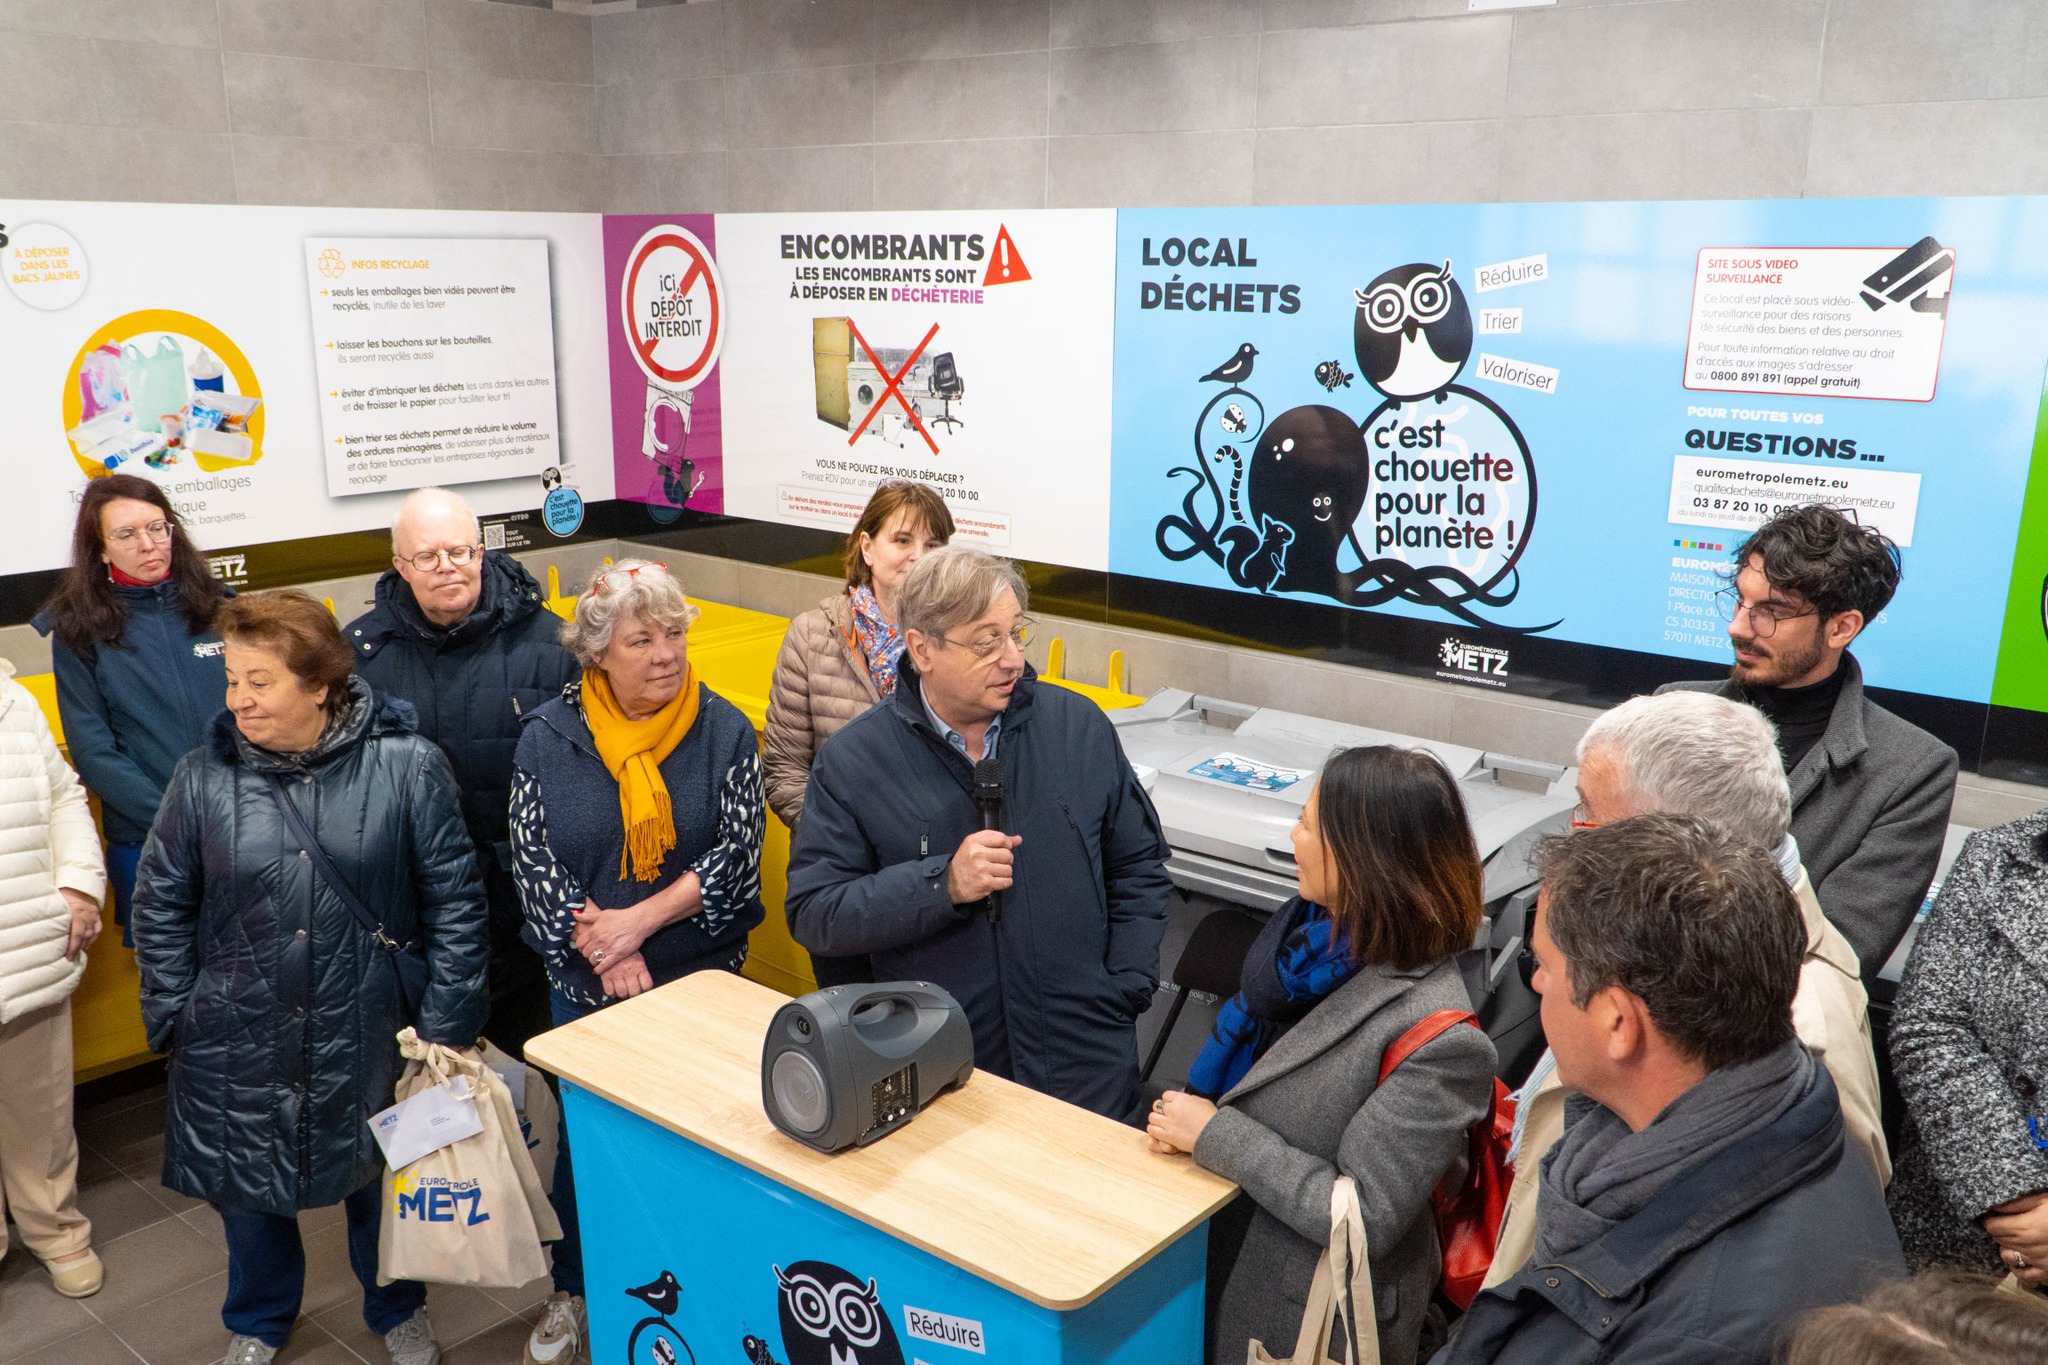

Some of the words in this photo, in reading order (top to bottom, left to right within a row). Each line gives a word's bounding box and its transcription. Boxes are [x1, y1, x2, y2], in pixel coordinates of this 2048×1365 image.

[15, 247, 23, 258] À
[24, 246, 70, 258] DÉPOSER
[781, 233, 985, 261] ENCOMBRANTS
[1142, 237, 1257, 267] LOCAL
[20, 260, 49, 271] DANS
[52, 259, 68, 269] LES
[351, 260, 378, 269] INFOS
[381, 260, 430, 269] RECYCLAGE
[1708, 259, 1729, 269] SITE
[1731, 259, 1762, 269] SOUS
[1765, 259, 1799, 269] VIDEO
[12, 273, 40, 284] BACS
[43, 270, 80, 282] JAUNES
[795, 266, 819, 280] LES
[823, 266, 931, 283] ENCOMBRANTS
[935, 269, 976, 284] SONT
[1479, 260, 1544, 288] Réduire
[1706, 273, 1783, 284] SURVEILLANCE
[332, 287, 354, 297] seuls
[357, 287, 368, 296] les
[371, 286, 421, 298] emballages
[424, 286, 441, 295] bien
[444, 285, 465, 295] vidés
[467, 286, 499, 296] peuvent
[501, 285, 516, 294] être
[790, 282, 800, 299] À
[802, 282, 865, 301] DÉPOSER
[869, 287, 887, 301] EN
[891, 284, 984, 304] DÉCHÈTERIE
[1140, 273, 1301, 314] DÉCHETS
[1704, 293, 1717, 304] Ce
[1720, 293, 1744, 304] local
[1746, 295, 1761, 305] est
[1763, 294, 1792, 306] placé
[1794, 297, 1819, 306] sous
[651, 295, 693, 318] DÉPÔT
[1702, 308, 1761, 319] surveillance
[1763, 311, 1787, 321] pour
[1790, 310, 1809, 320] des
[1812, 311, 1851, 321] raisons
[645, 320, 702, 338] INTERDIT
[1483, 312, 1519, 331] Trier
[1700, 322, 1713, 332] de
[1716, 322, 1755, 333] sécurité
[1757, 324, 1776, 334] des
[1779, 324, 1807, 335] biens
[1809, 326, 1820, 336] et
[1822, 325, 1841, 336] des
[1844, 328, 1904, 338] personnes.
[337, 340, 365, 349] laisser
[367, 339, 379, 348] les
[382, 337, 423, 348] bouchons
[440, 336, 451, 345] les
[1698, 341, 1720, 352] Pour
[1724, 343, 1748, 353] toute
[1751, 343, 1809, 355] information
[1811, 346, 1850, 357] relative
[1852, 349, 1866, 358] au
[1869, 347, 1895, 359] droit
[1696, 356, 1733, 367] d'accès
[1736, 359, 1755, 368] aux
[1757, 358, 1795, 371] images
[1798, 360, 1853, 372] s'adresser
[1482, 357, 1554, 390] Valoriser
[1710, 370, 1738, 381] 0800
[1740, 372, 1759, 382] 891
[1762, 373, 1780, 383] 891
[1783, 374, 1818, 386] (appel
[1820, 377, 1861, 389] gratuit)
[341, 389, 365, 398] éviter
[368, 386, 416, 397] d'imbriquer
[419, 384, 431, 393] les
[433, 382, 464, 392] déchets
[467, 381, 477, 390] les
[495, 380, 513, 389] dans
[515, 379, 525, 387] les
[527, 378, 549, 386] autres
[1687, 406, 1727, 419] POUR
[1730, 408, 1788, 423] TOUTES
[1792, 412, 1824, 425] VOS
[345, 435, 363, 444] bien
[366, 433, 382, 442] trier
[384, 433, 397, 441] ses
[400, 430, 430, 440] déchets
[433, 428, 461, 439] permet
[462, 426, 472, 435] de
[474, 424, 500, 433] réduire
[502, 423, 509, 431] le
[510, 421, 537, 430] volume
[1374, 418, 1446, 449] c'est
[1684, 428, 1885, 462] QUESTIONS...
[816, 458, 836, 470] VOUS
[837, 461, 847, 471] NE
[849, 462, 878, 474] POUVEZ
[880, 466, 894, 476] PAS
[896, 468, 917, 479] VOUS
[920, 469, 957, 483] DÉPLACER
[960, 475, 964, 484] ?
[1374, 452, 1514, 482] chouette
[175, 476, 251, 494] emballages
[801, 470, 824, 482] Prenez
[825, 474, 839, 483] RDV
[840, 476, 856, 487] pour
[857, 479, 866, 487] un
[1696, 468, 1849, 489] eurometropolemetz.eu
[945, 488, 955, 498] 20
[958, 489, 966, 499] 10
[968, 491, 979, 500] 00
[1374, 489, 1447, 523] pour
[1458, 483, 1485, 516] la
[550, 498, 578, 511] chouette
[1693, 497, 1709, 508] 03
[1714, 499, 1729, 509] 87
[1733, 501, 1749, 512] 20
[1754, 502, 1768, 513] 10
[551, 509, 566, 519] pour
[1374, 517, 1495, 555] planète
[1506, 519, 1515, 550] !
[209, 559, 247, 579] ETZ
[1670, 571, 1714, 587] MAISON
[1674, 601, 1703, 615] Place
[1705, 606, 1719, 617] du
[1665, 615, 1679, 627] CS
[1681, 617, 1715, 632] 30353
[1664, 630, 1691, 643] 57011
[1694, 635, 1724, 648] METZ
[1445, 649, 1509, 677] METZ
[1436, 671, 1506, 687] eurometropolemetz.eu
[910, 1311, 980, 1348] Réduire
